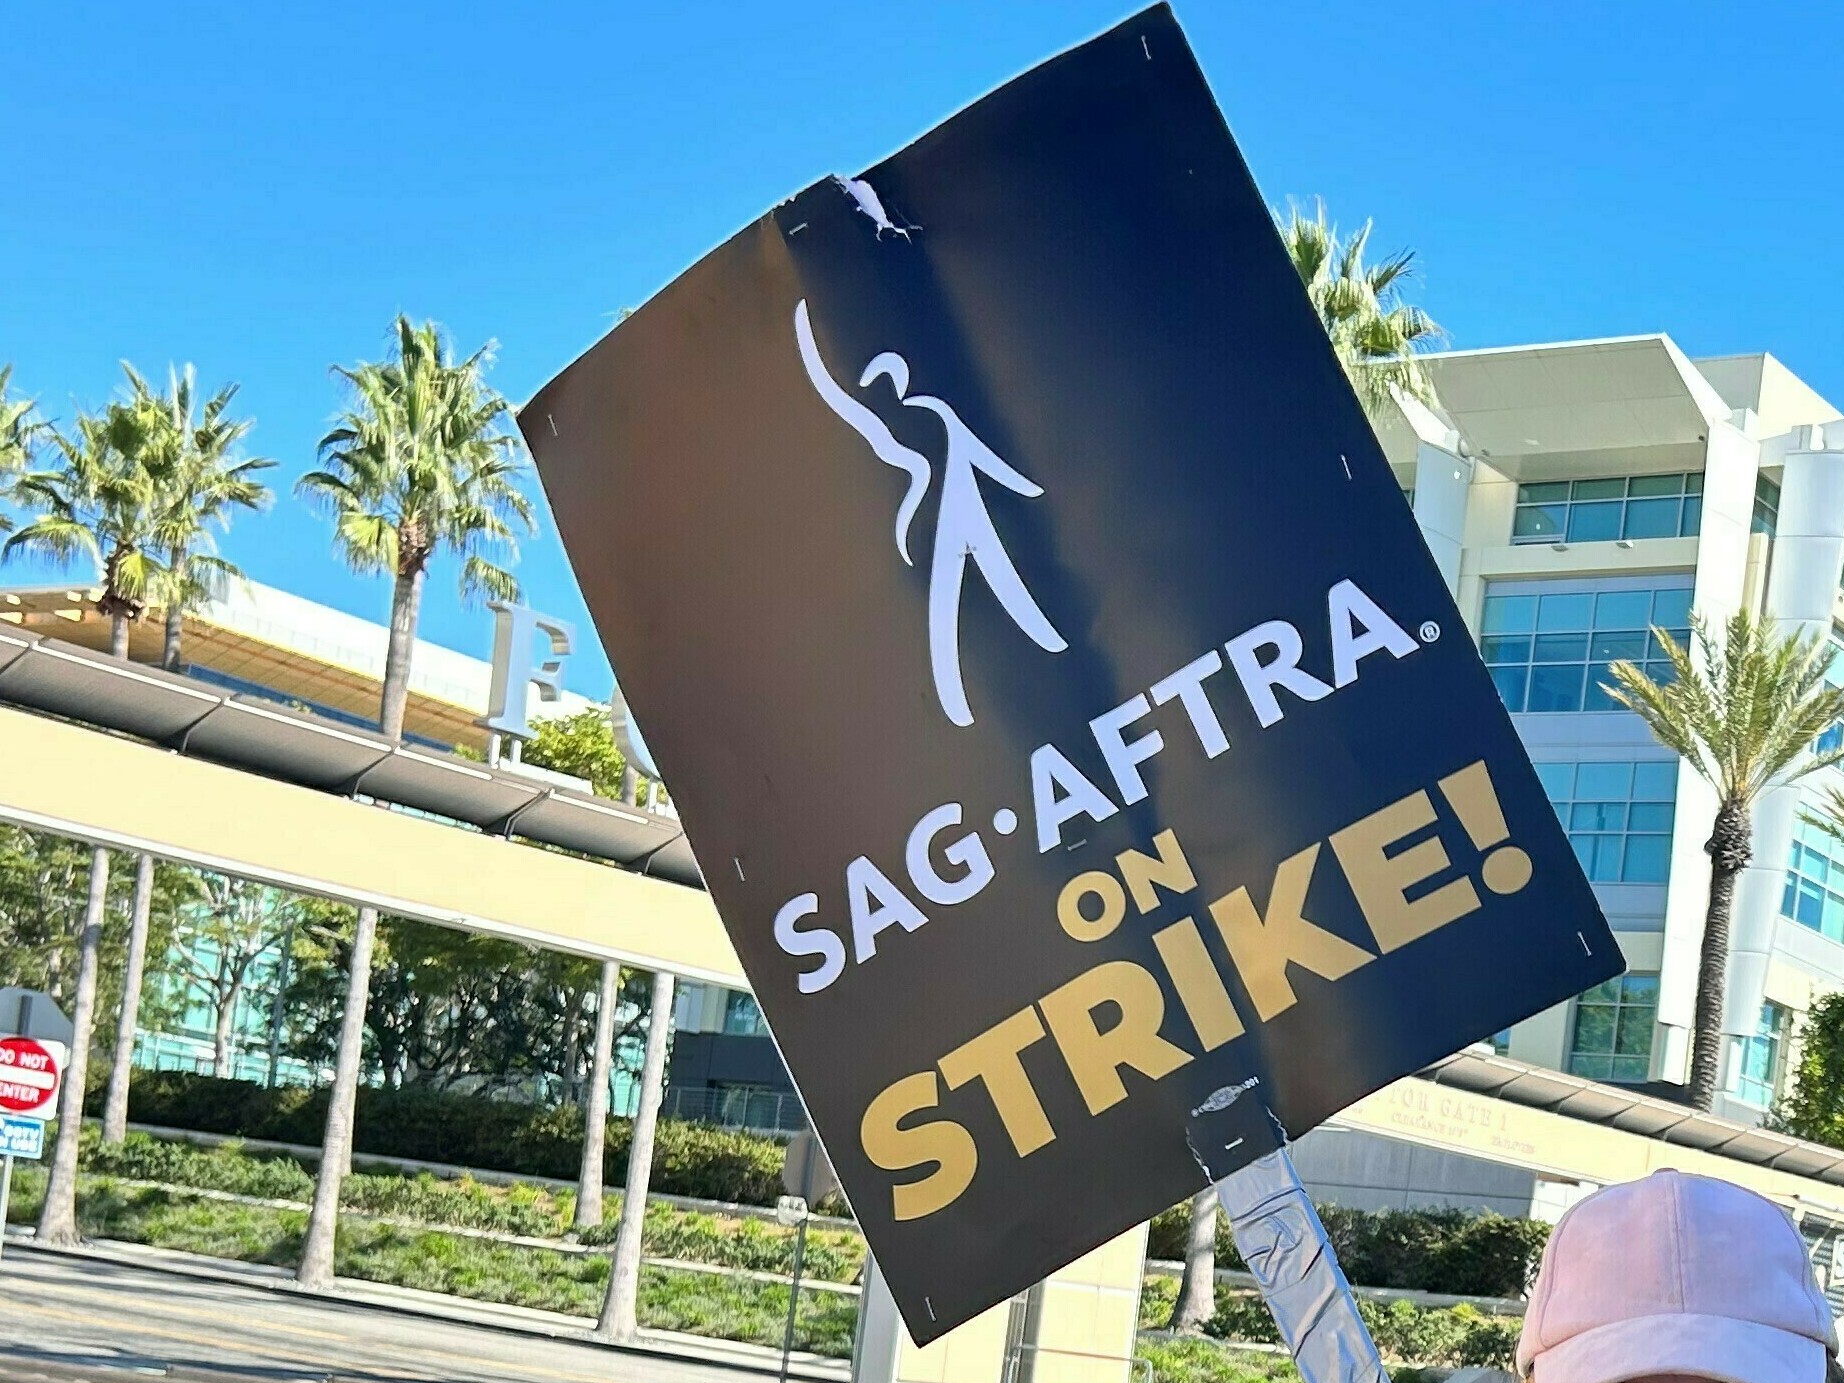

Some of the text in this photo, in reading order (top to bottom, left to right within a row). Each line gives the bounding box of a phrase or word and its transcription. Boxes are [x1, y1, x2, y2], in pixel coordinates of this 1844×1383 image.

[1057, 829, 1197, 942] ON
[861, 760, 1533, 1221] STRIKE!
[19, 1051, 49, 1070] NOT
